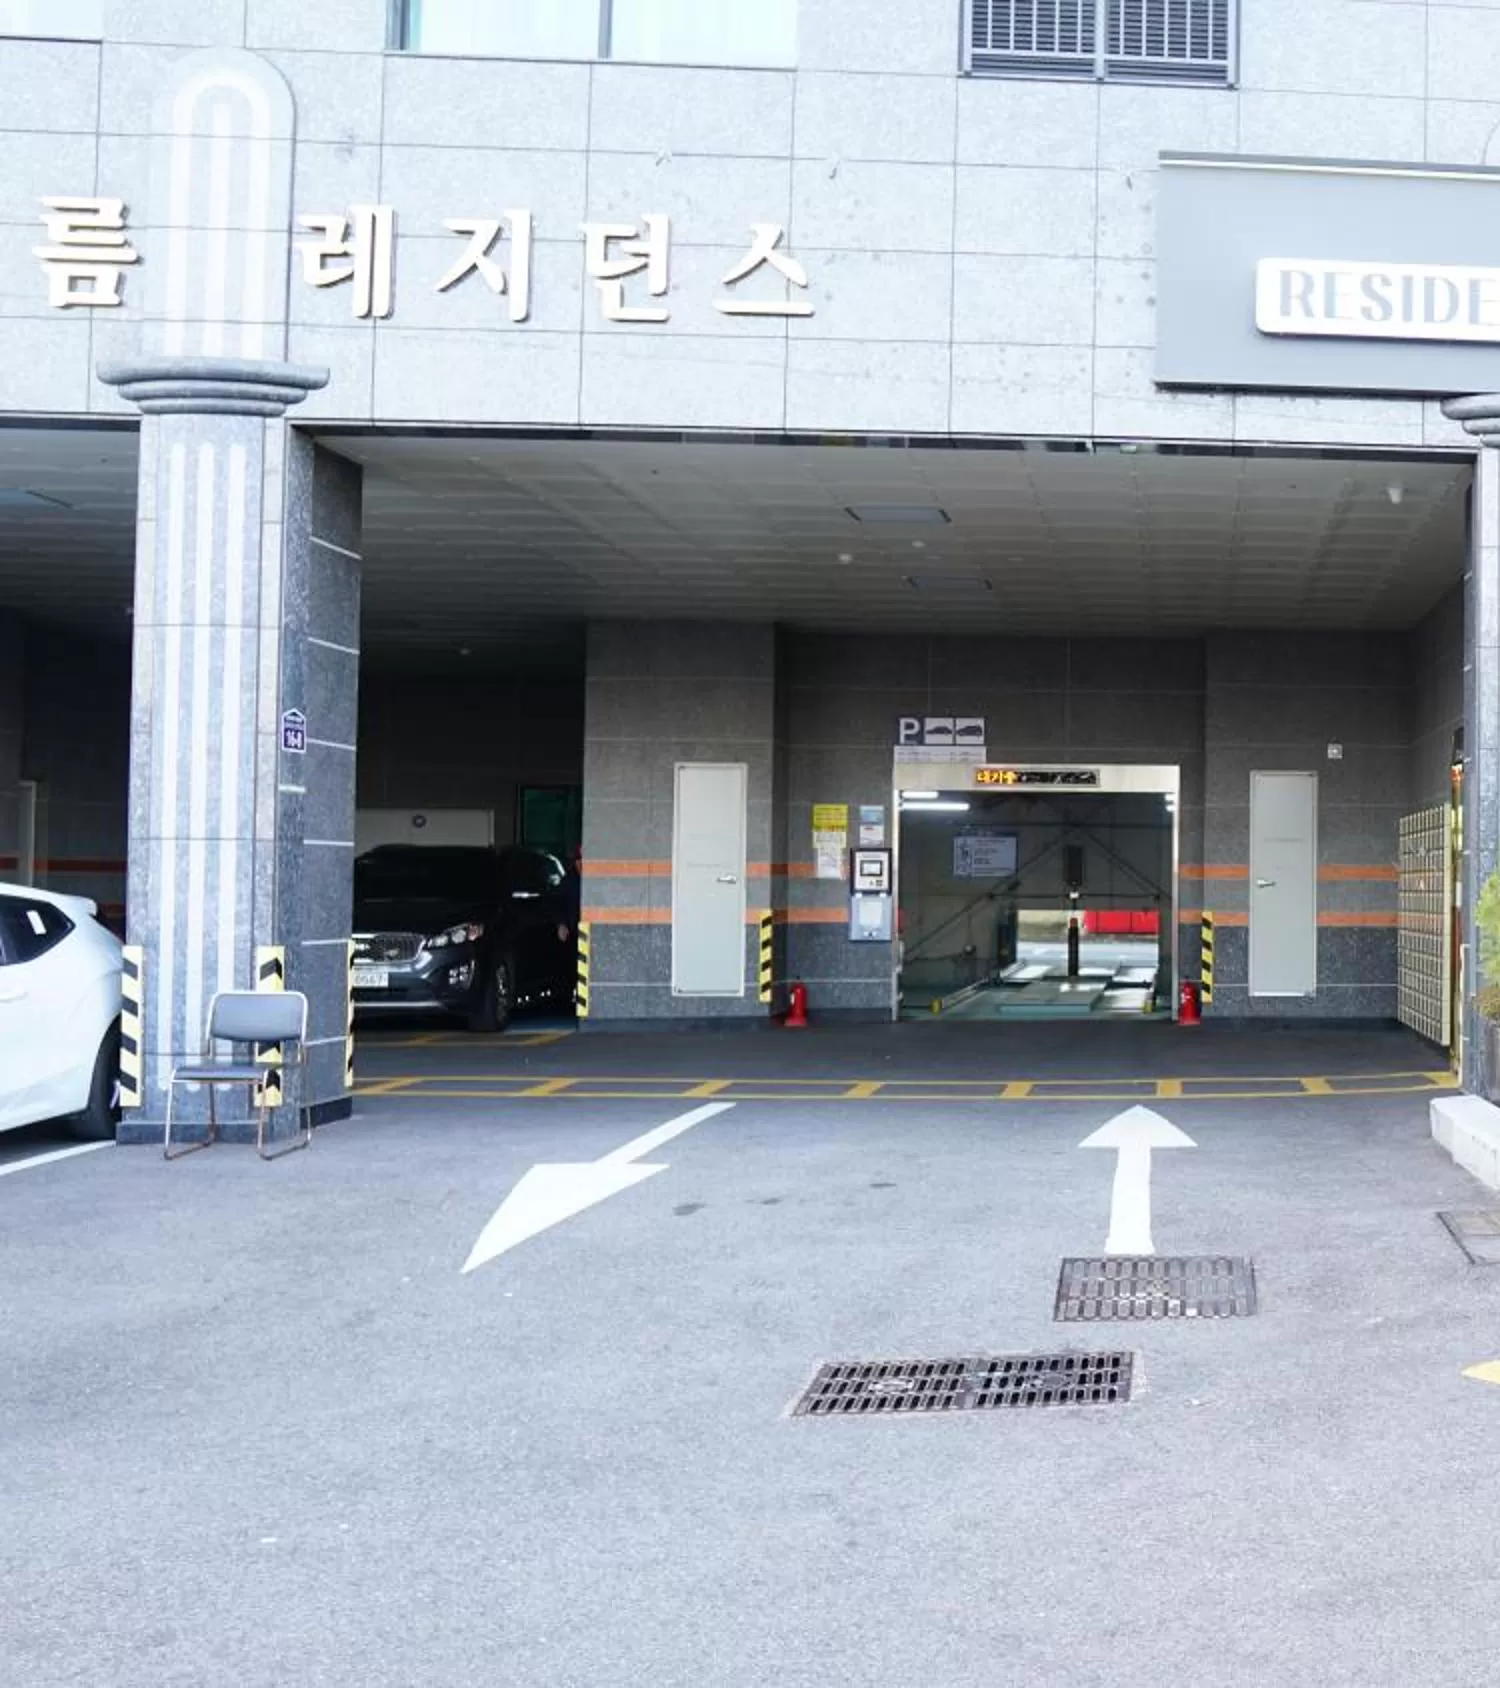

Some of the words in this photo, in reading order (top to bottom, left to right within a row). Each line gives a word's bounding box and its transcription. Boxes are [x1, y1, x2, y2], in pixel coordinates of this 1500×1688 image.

[32, 195, 140, 308] 름
[295, 203, 815, 324] 레지던스
[899, 717, 921, 745] P
